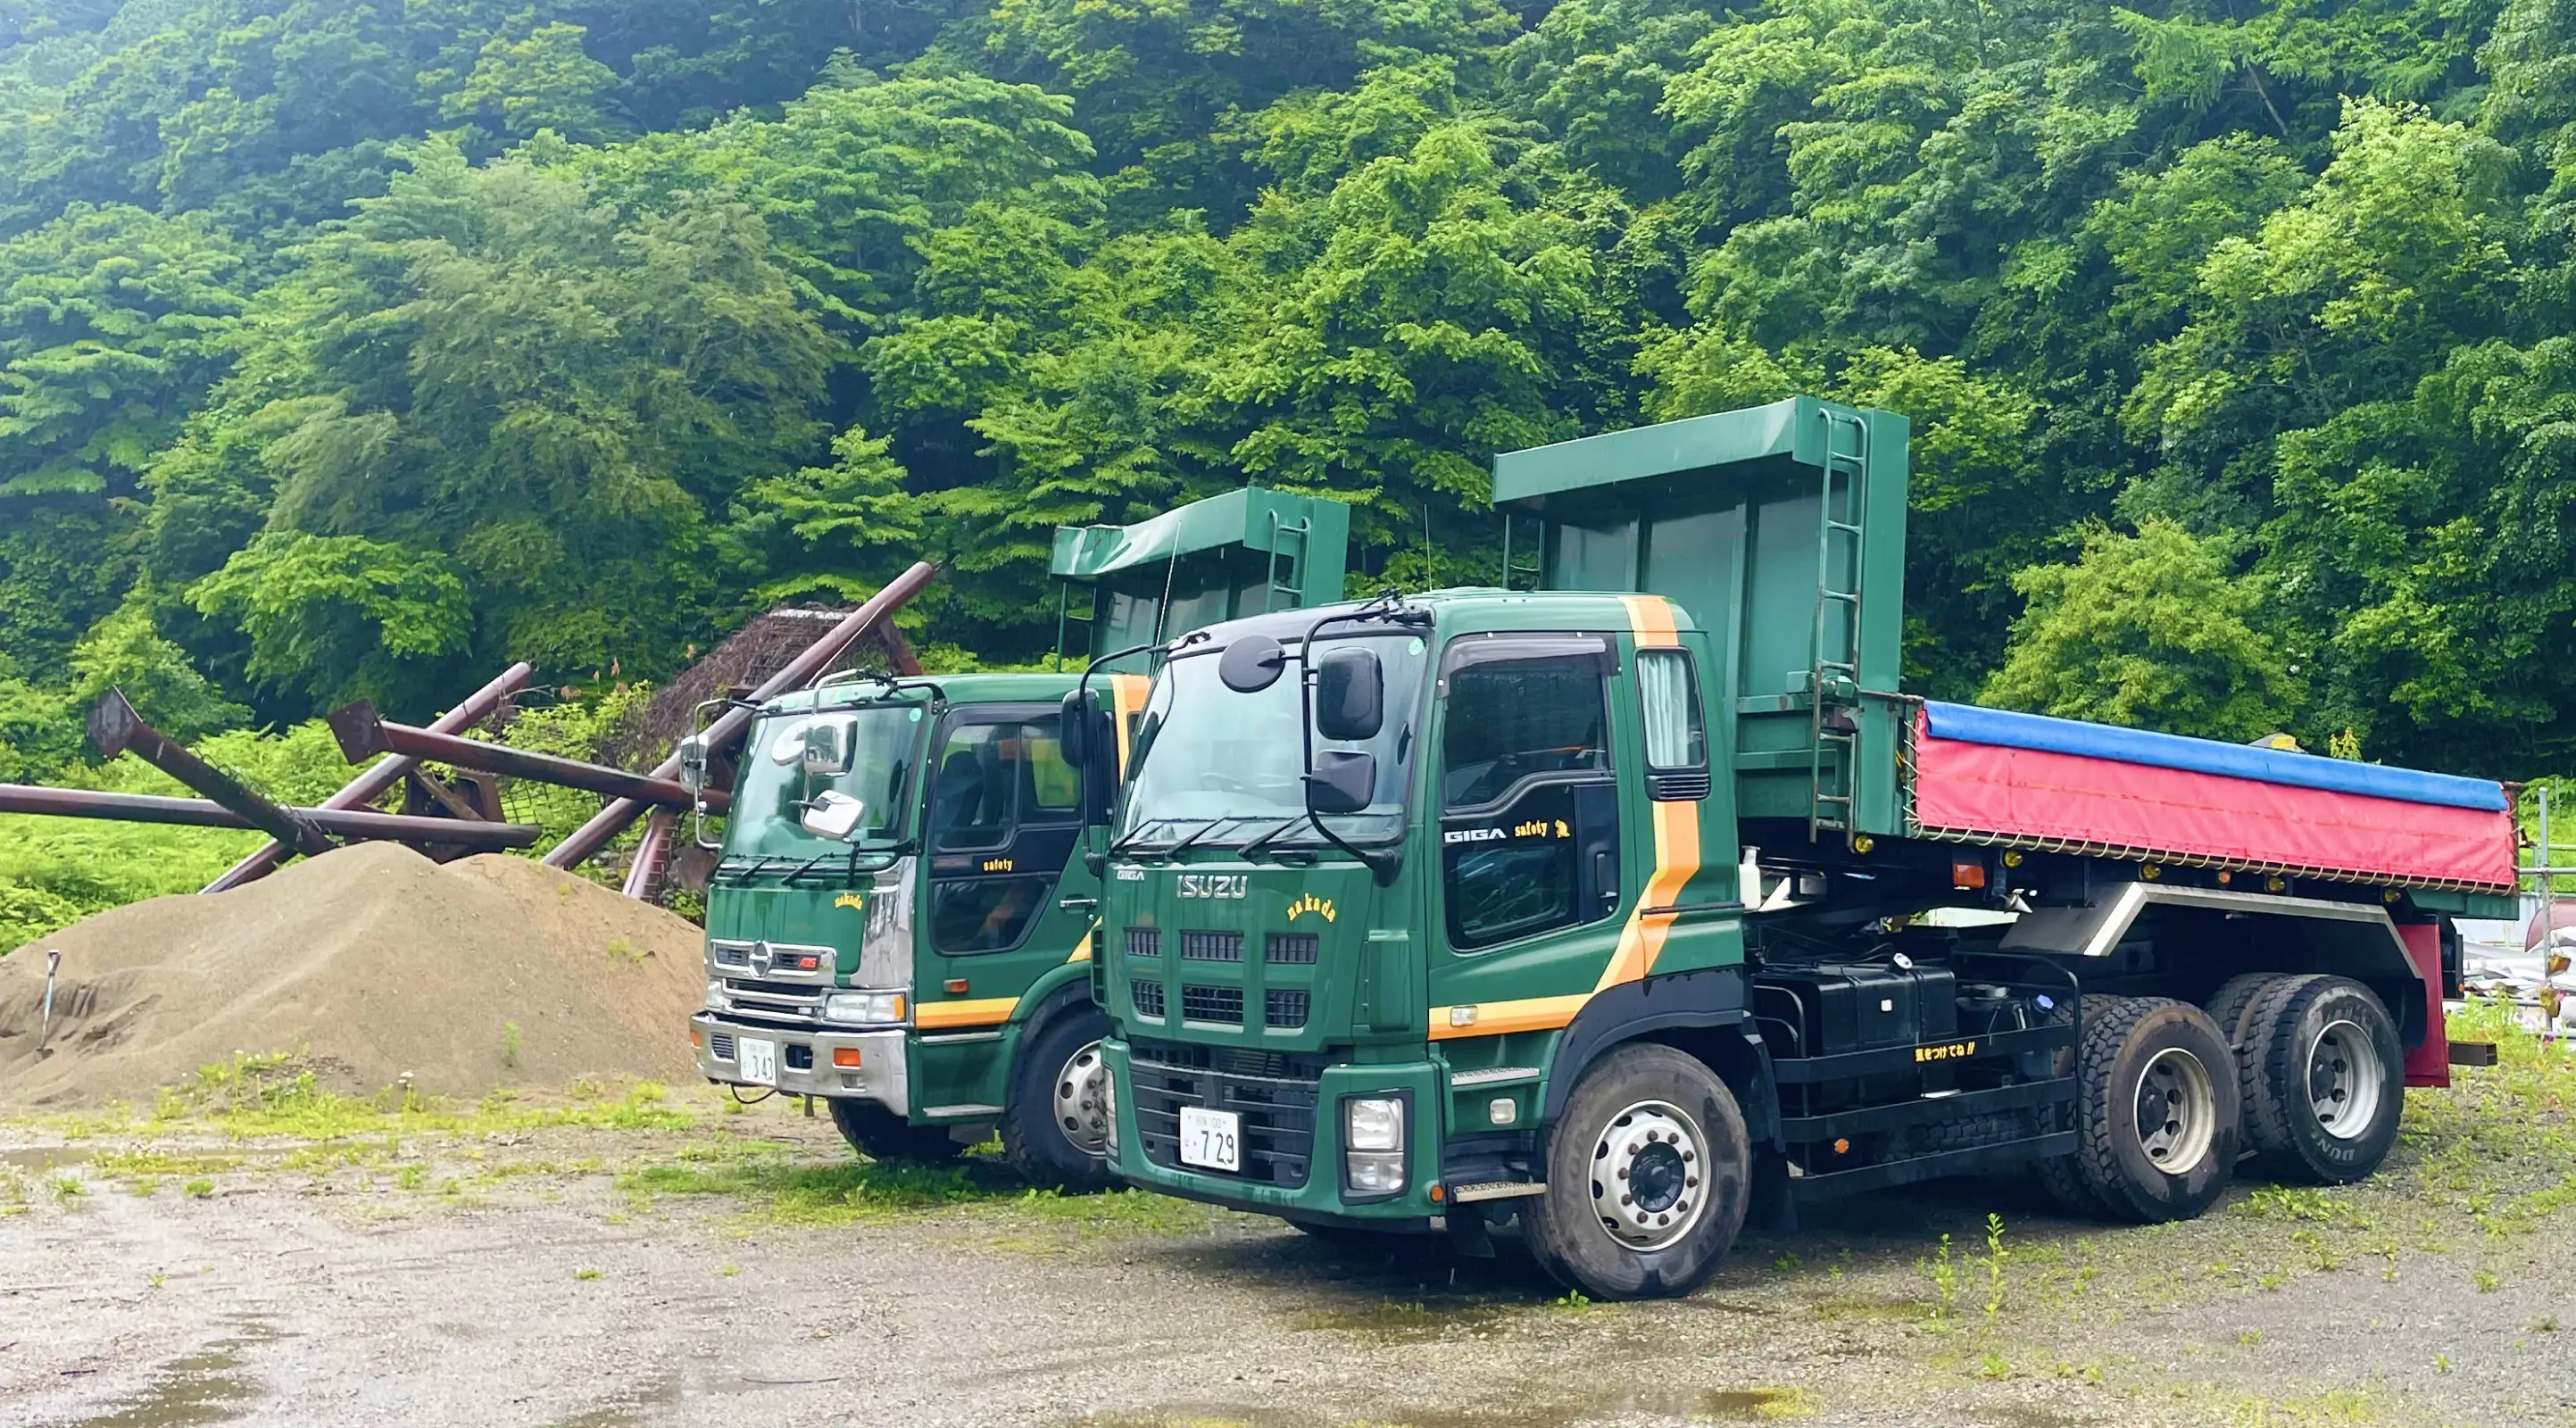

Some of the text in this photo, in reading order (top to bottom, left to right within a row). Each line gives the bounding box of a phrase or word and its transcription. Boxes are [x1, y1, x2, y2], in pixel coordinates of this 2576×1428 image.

[1444, 828, 1507, 843] GIGA
[1515, 820, 1548, 837] safety
[983, 859, 1012, 871] safety
[1117, 870, 1144, 881] GIGA
[1176, 875, 1248, 899] ISUZU
[1287, 892, 1335, 923] nakada
[1201, 1130, 1234, 1165] 729
